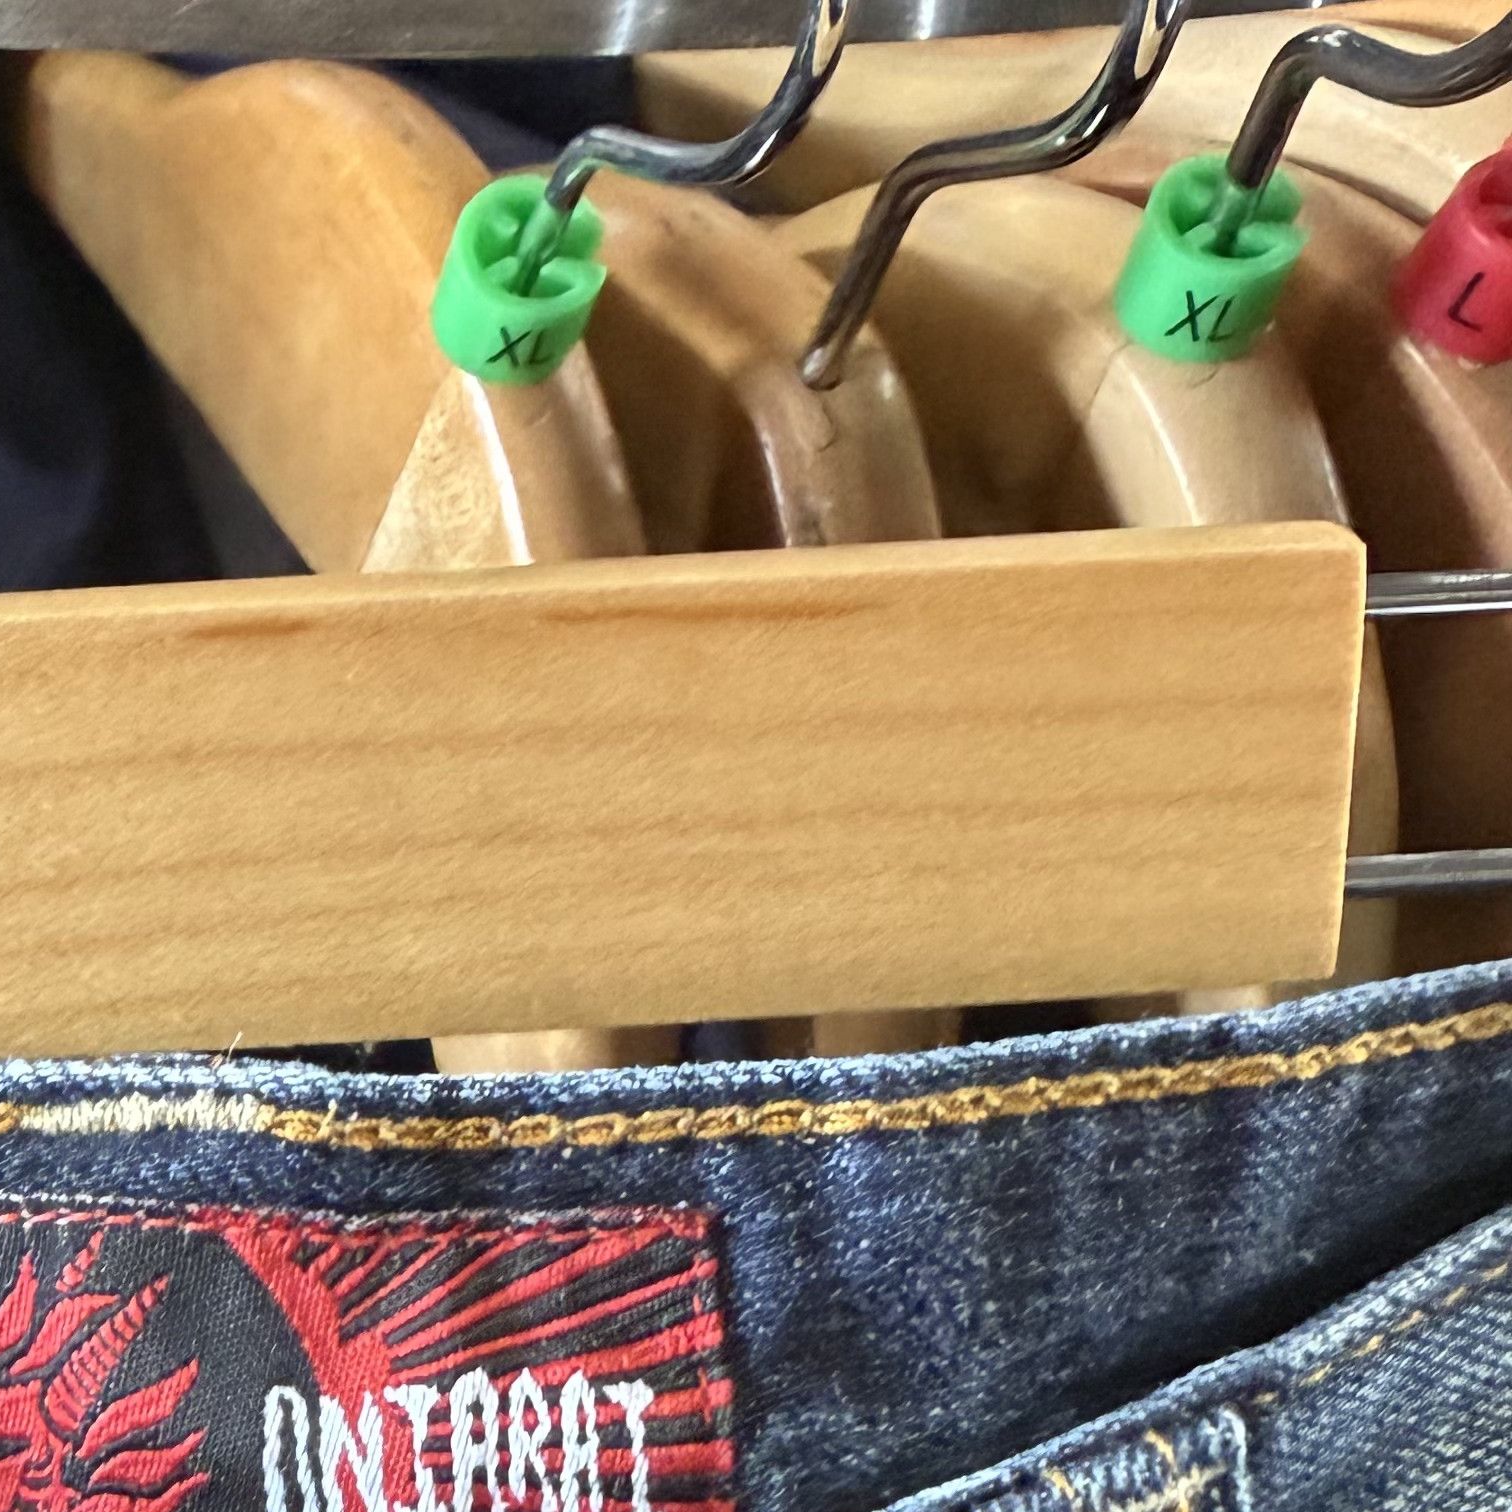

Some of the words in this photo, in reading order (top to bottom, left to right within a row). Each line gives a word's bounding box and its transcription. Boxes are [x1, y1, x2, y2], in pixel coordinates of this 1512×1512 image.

[1164, 289, 1237, 343] XL
[1447, 271, 1486, 332] L
[485, 326, 551, 368] XL
